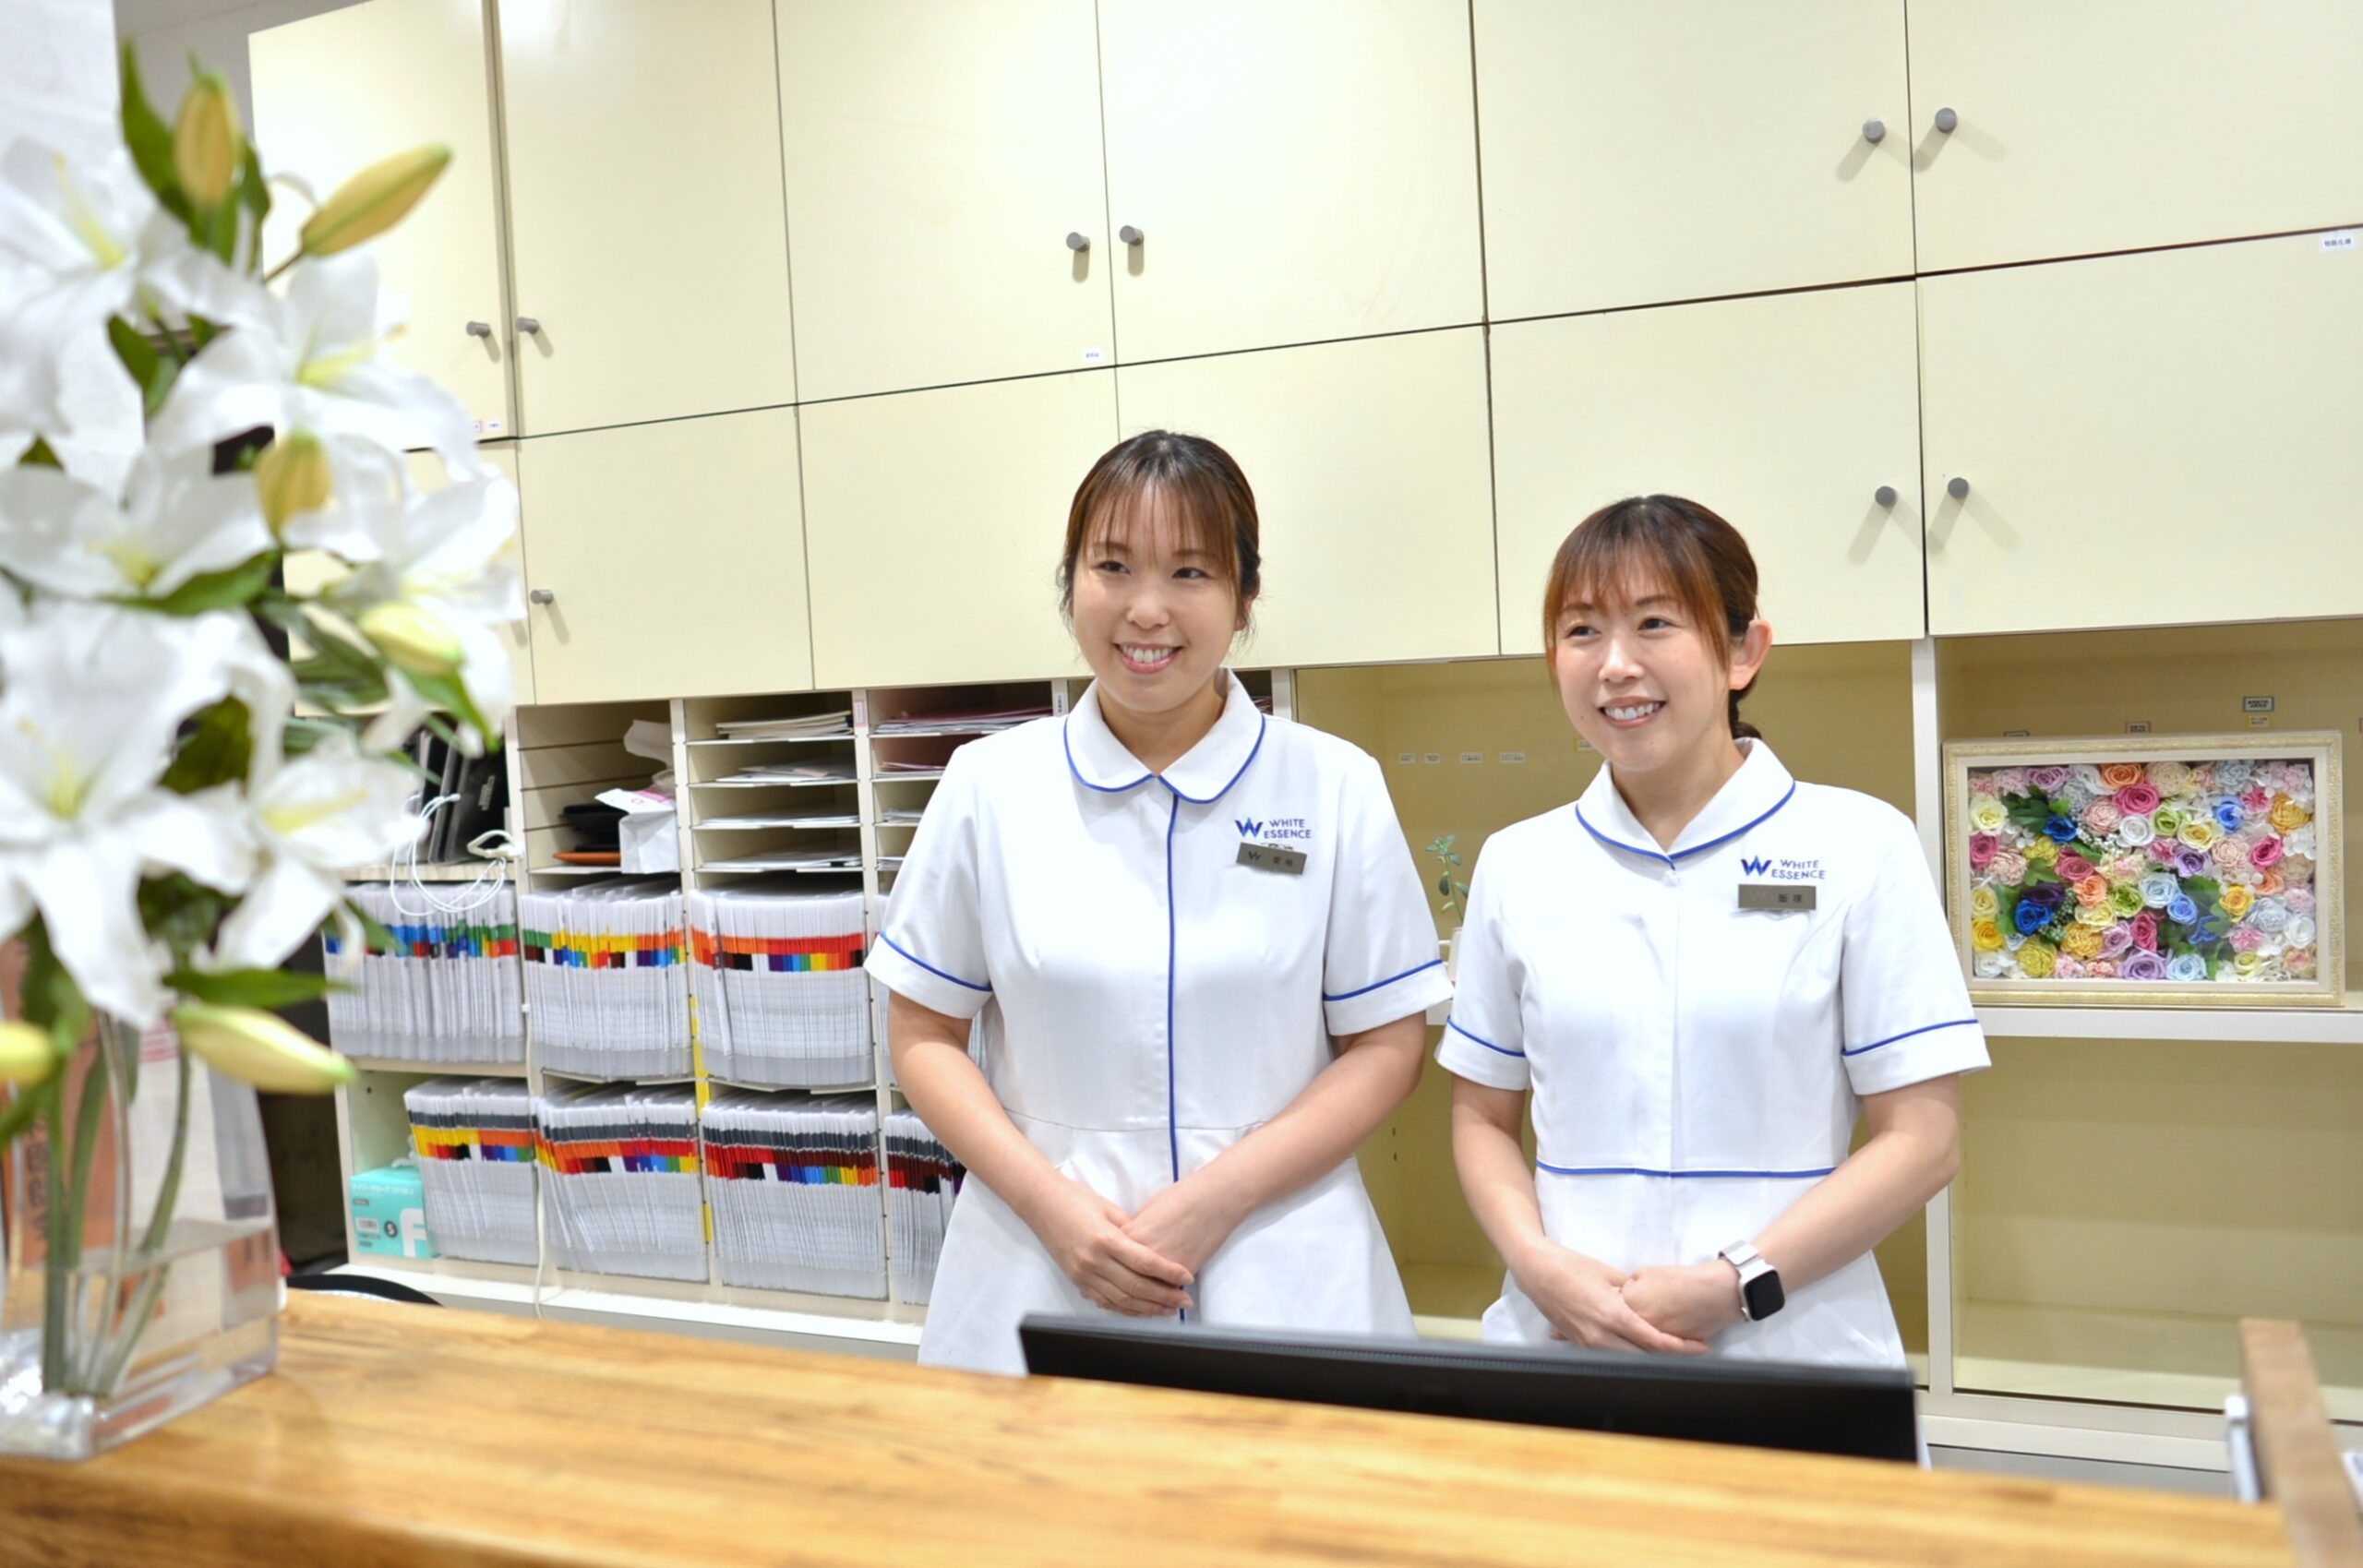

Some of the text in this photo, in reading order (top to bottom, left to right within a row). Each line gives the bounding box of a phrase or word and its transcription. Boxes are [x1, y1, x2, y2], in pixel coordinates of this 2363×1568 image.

[1268, 819, 1305, 828] WHITE
[1264, 829, 1312, 839] ESSENCE
[1780, 859, 1820, 869] WHITE
[1771, 868, 1826, 880] ESSENCE
